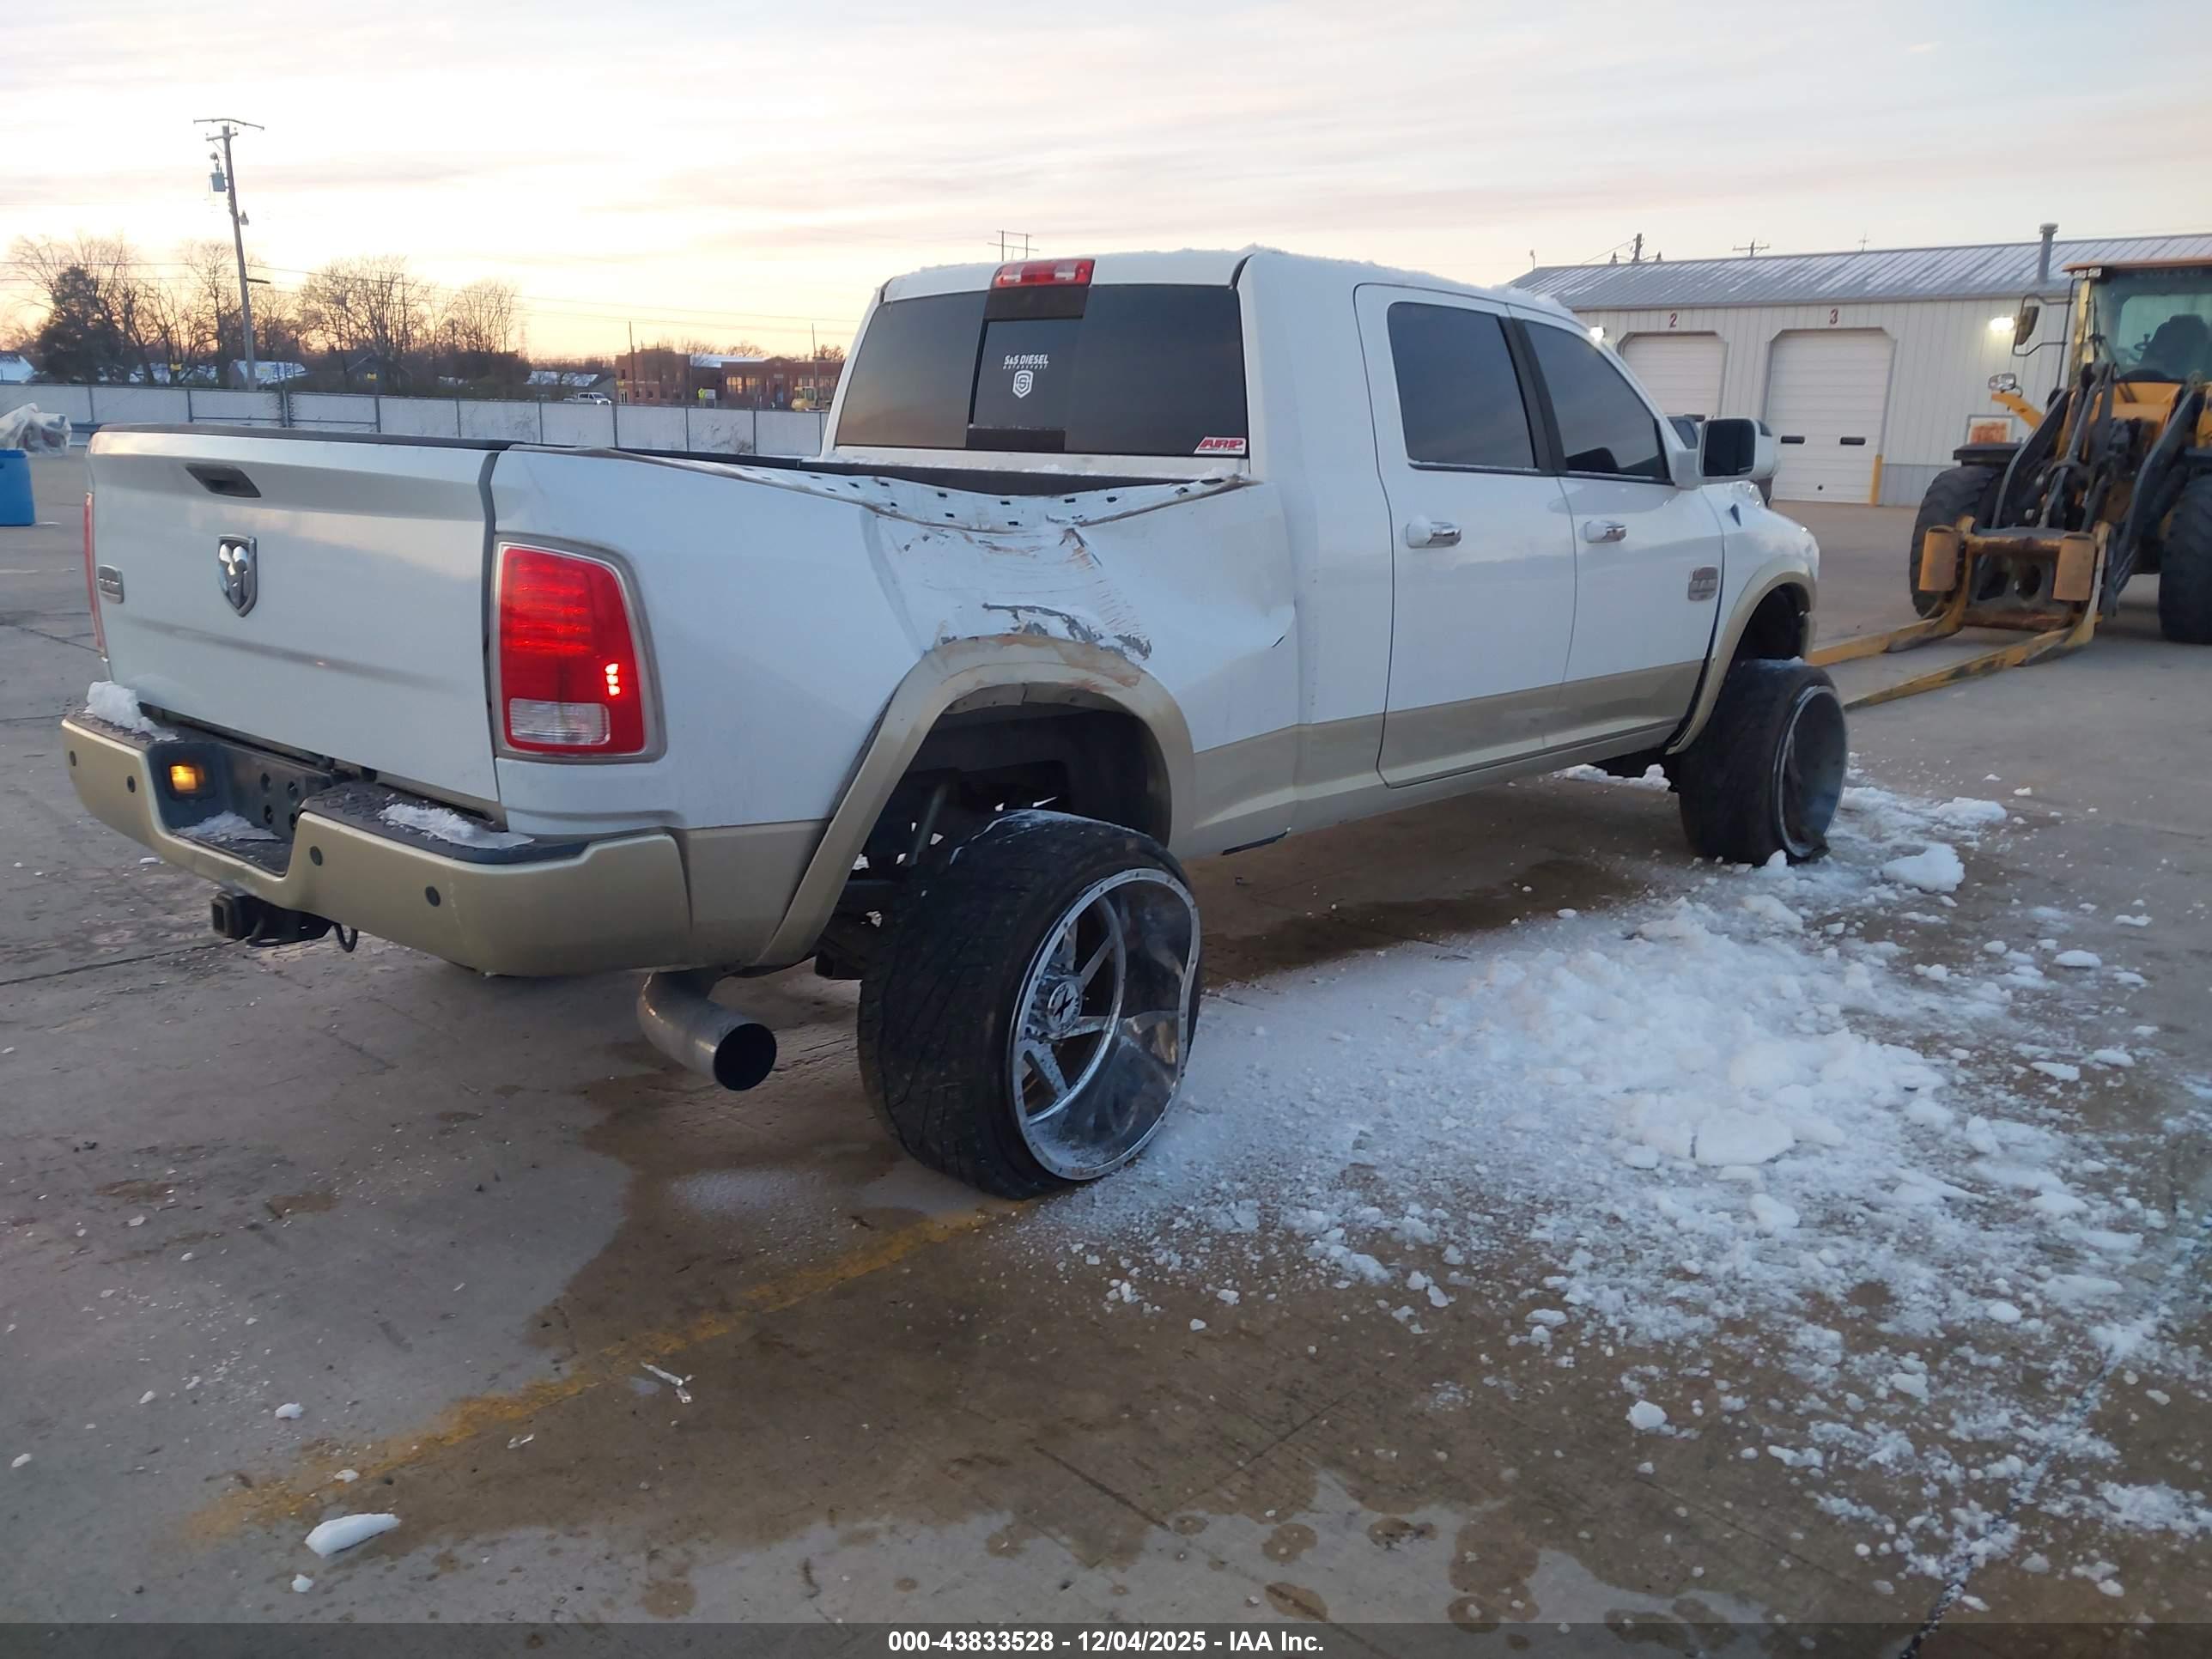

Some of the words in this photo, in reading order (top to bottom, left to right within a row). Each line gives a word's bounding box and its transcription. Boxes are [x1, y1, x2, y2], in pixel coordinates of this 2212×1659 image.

[1669, 313, 1677, 328] 2
[1830, 308, 1838, 325] 3
[1019, 354, 1048, 364] DIESEL
[1200, 439, 1243, 448] ARP
